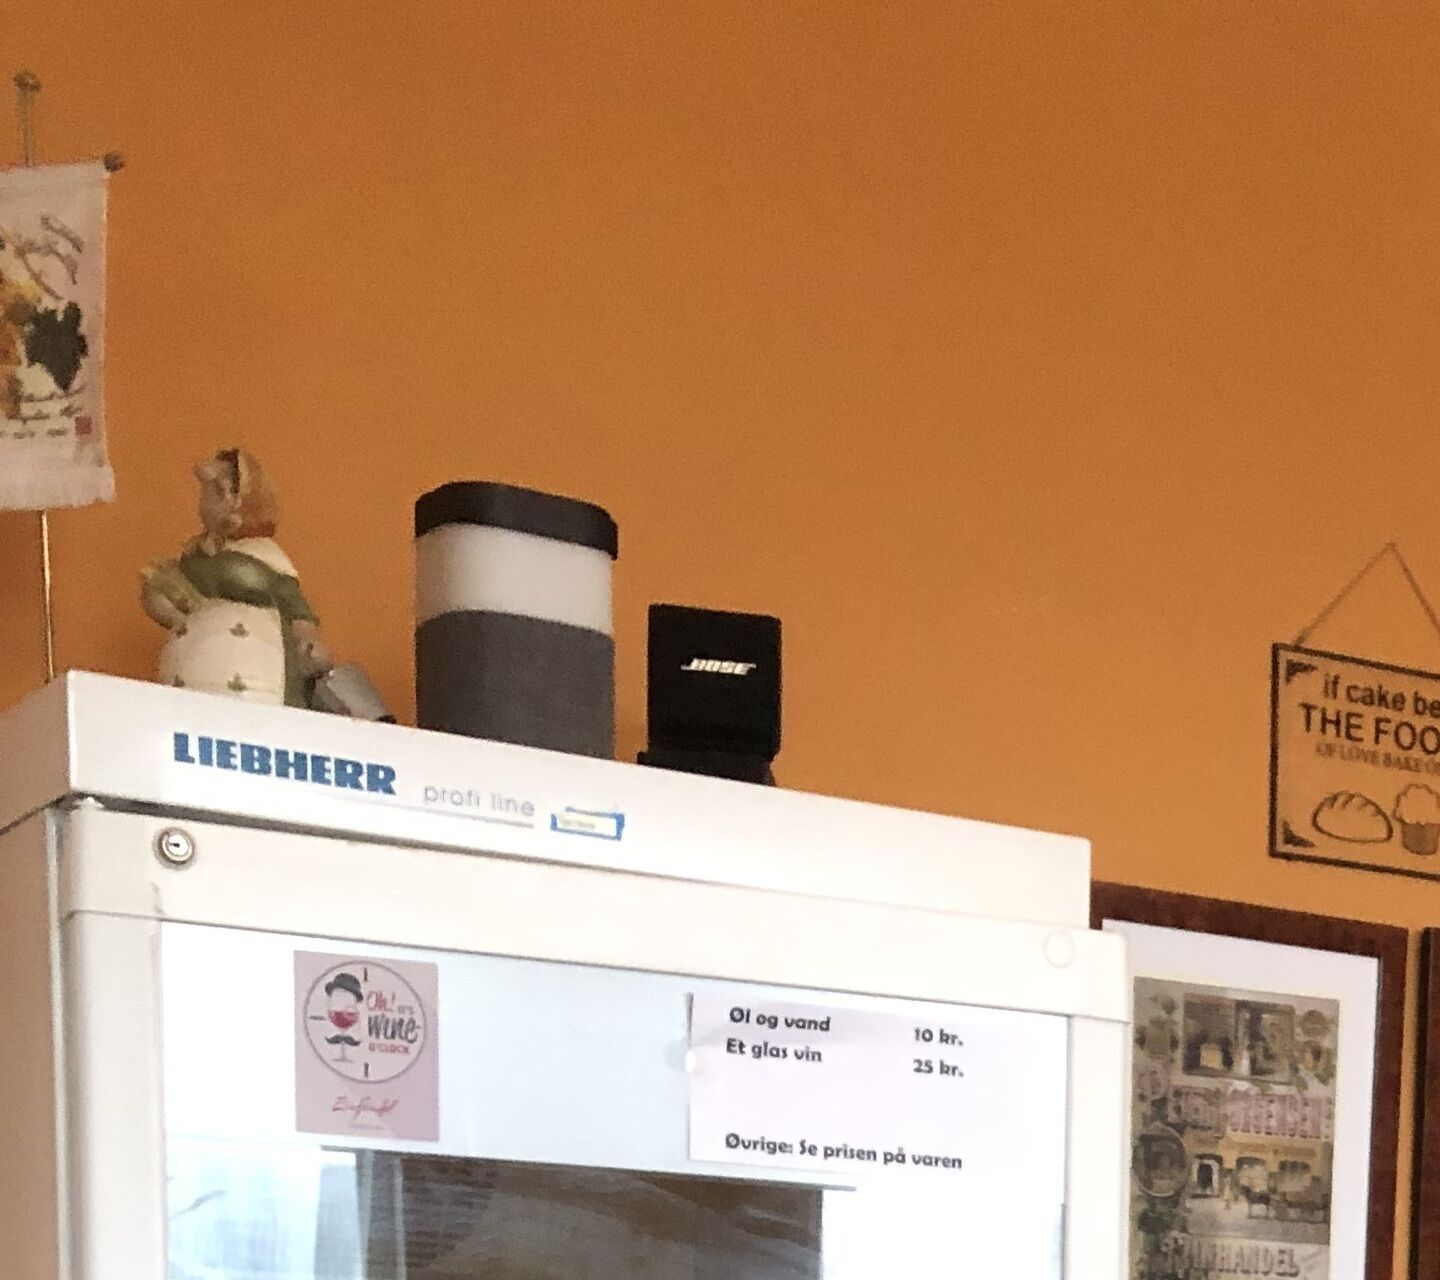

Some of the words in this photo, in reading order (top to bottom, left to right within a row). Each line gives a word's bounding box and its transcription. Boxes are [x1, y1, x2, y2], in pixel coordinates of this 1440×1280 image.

[680, 658, 757, 675] BOSE
[1346, 683, 1407, 712] cake
[1299, 702, 1365, 742] THE
[173, 732, 397, 795] LIEBHERR
[423, 784, 482, 808] profi
[490, 794, 536, 817] line
[756, 1014, 778, 1029] og
[785, 1016, 831, 1033] vand
[914, 1027, 933, 1043] 10
[939, 1028, 964, 1046] kr.
[726, 1038, 747, 1055] Et
[751, 1041, 788, 1060] glas
[793, 1046, 823, 1063] vin
[913, 1058, 934, 1075] 25
[939, 1059, 965, 1078] kr.
[799, 1138, 818, 1156] Se
[823, 1142, 878, 1163] prisen
[883, 1147, 907, 1166] på
[911, 1153, 963, 1170] varen
